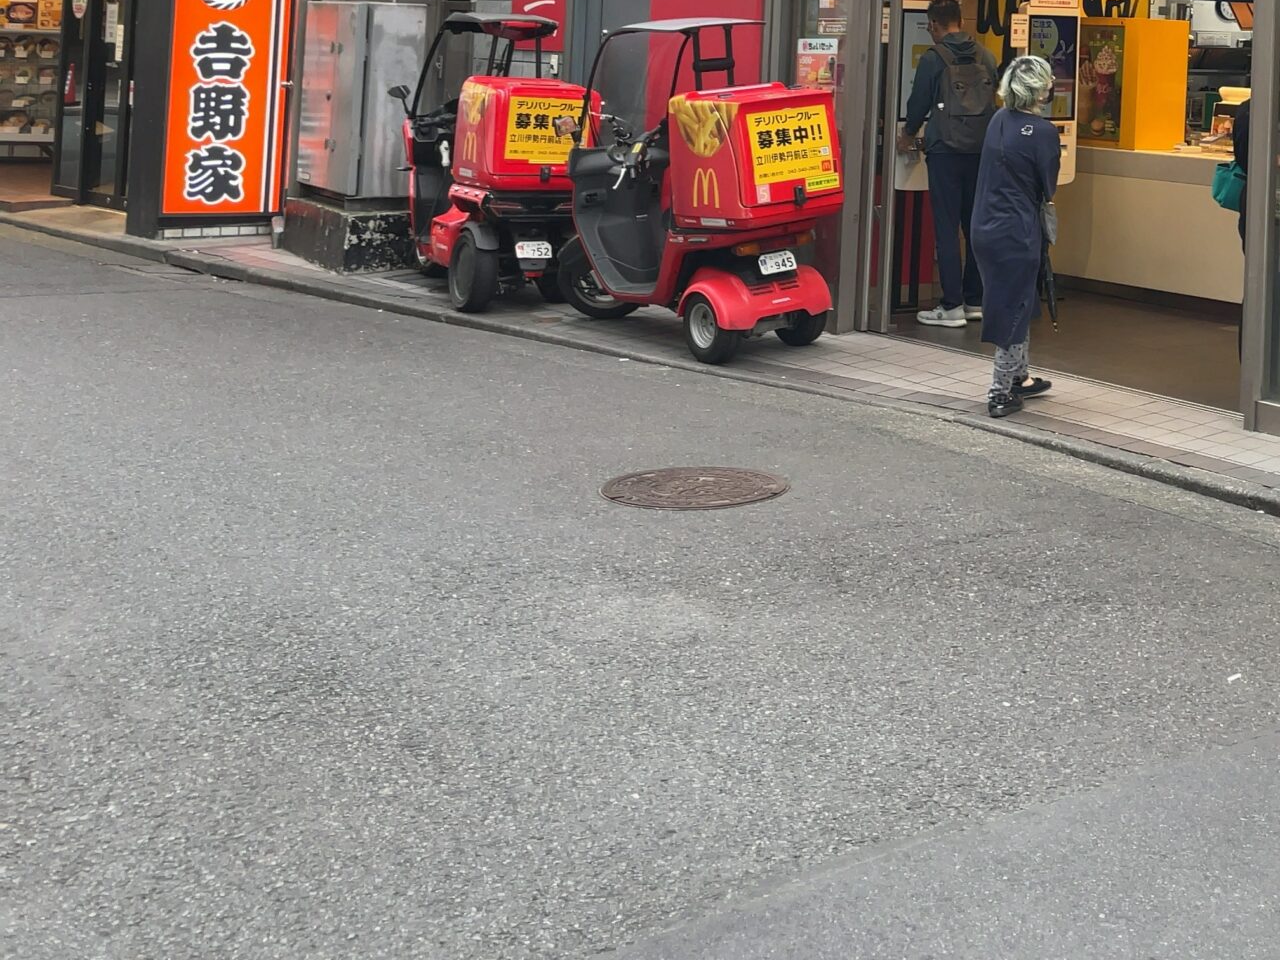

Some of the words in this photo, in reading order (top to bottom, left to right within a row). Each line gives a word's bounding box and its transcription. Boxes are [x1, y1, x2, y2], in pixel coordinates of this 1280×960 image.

[754, 111, 820, 127] デリバリークルー
